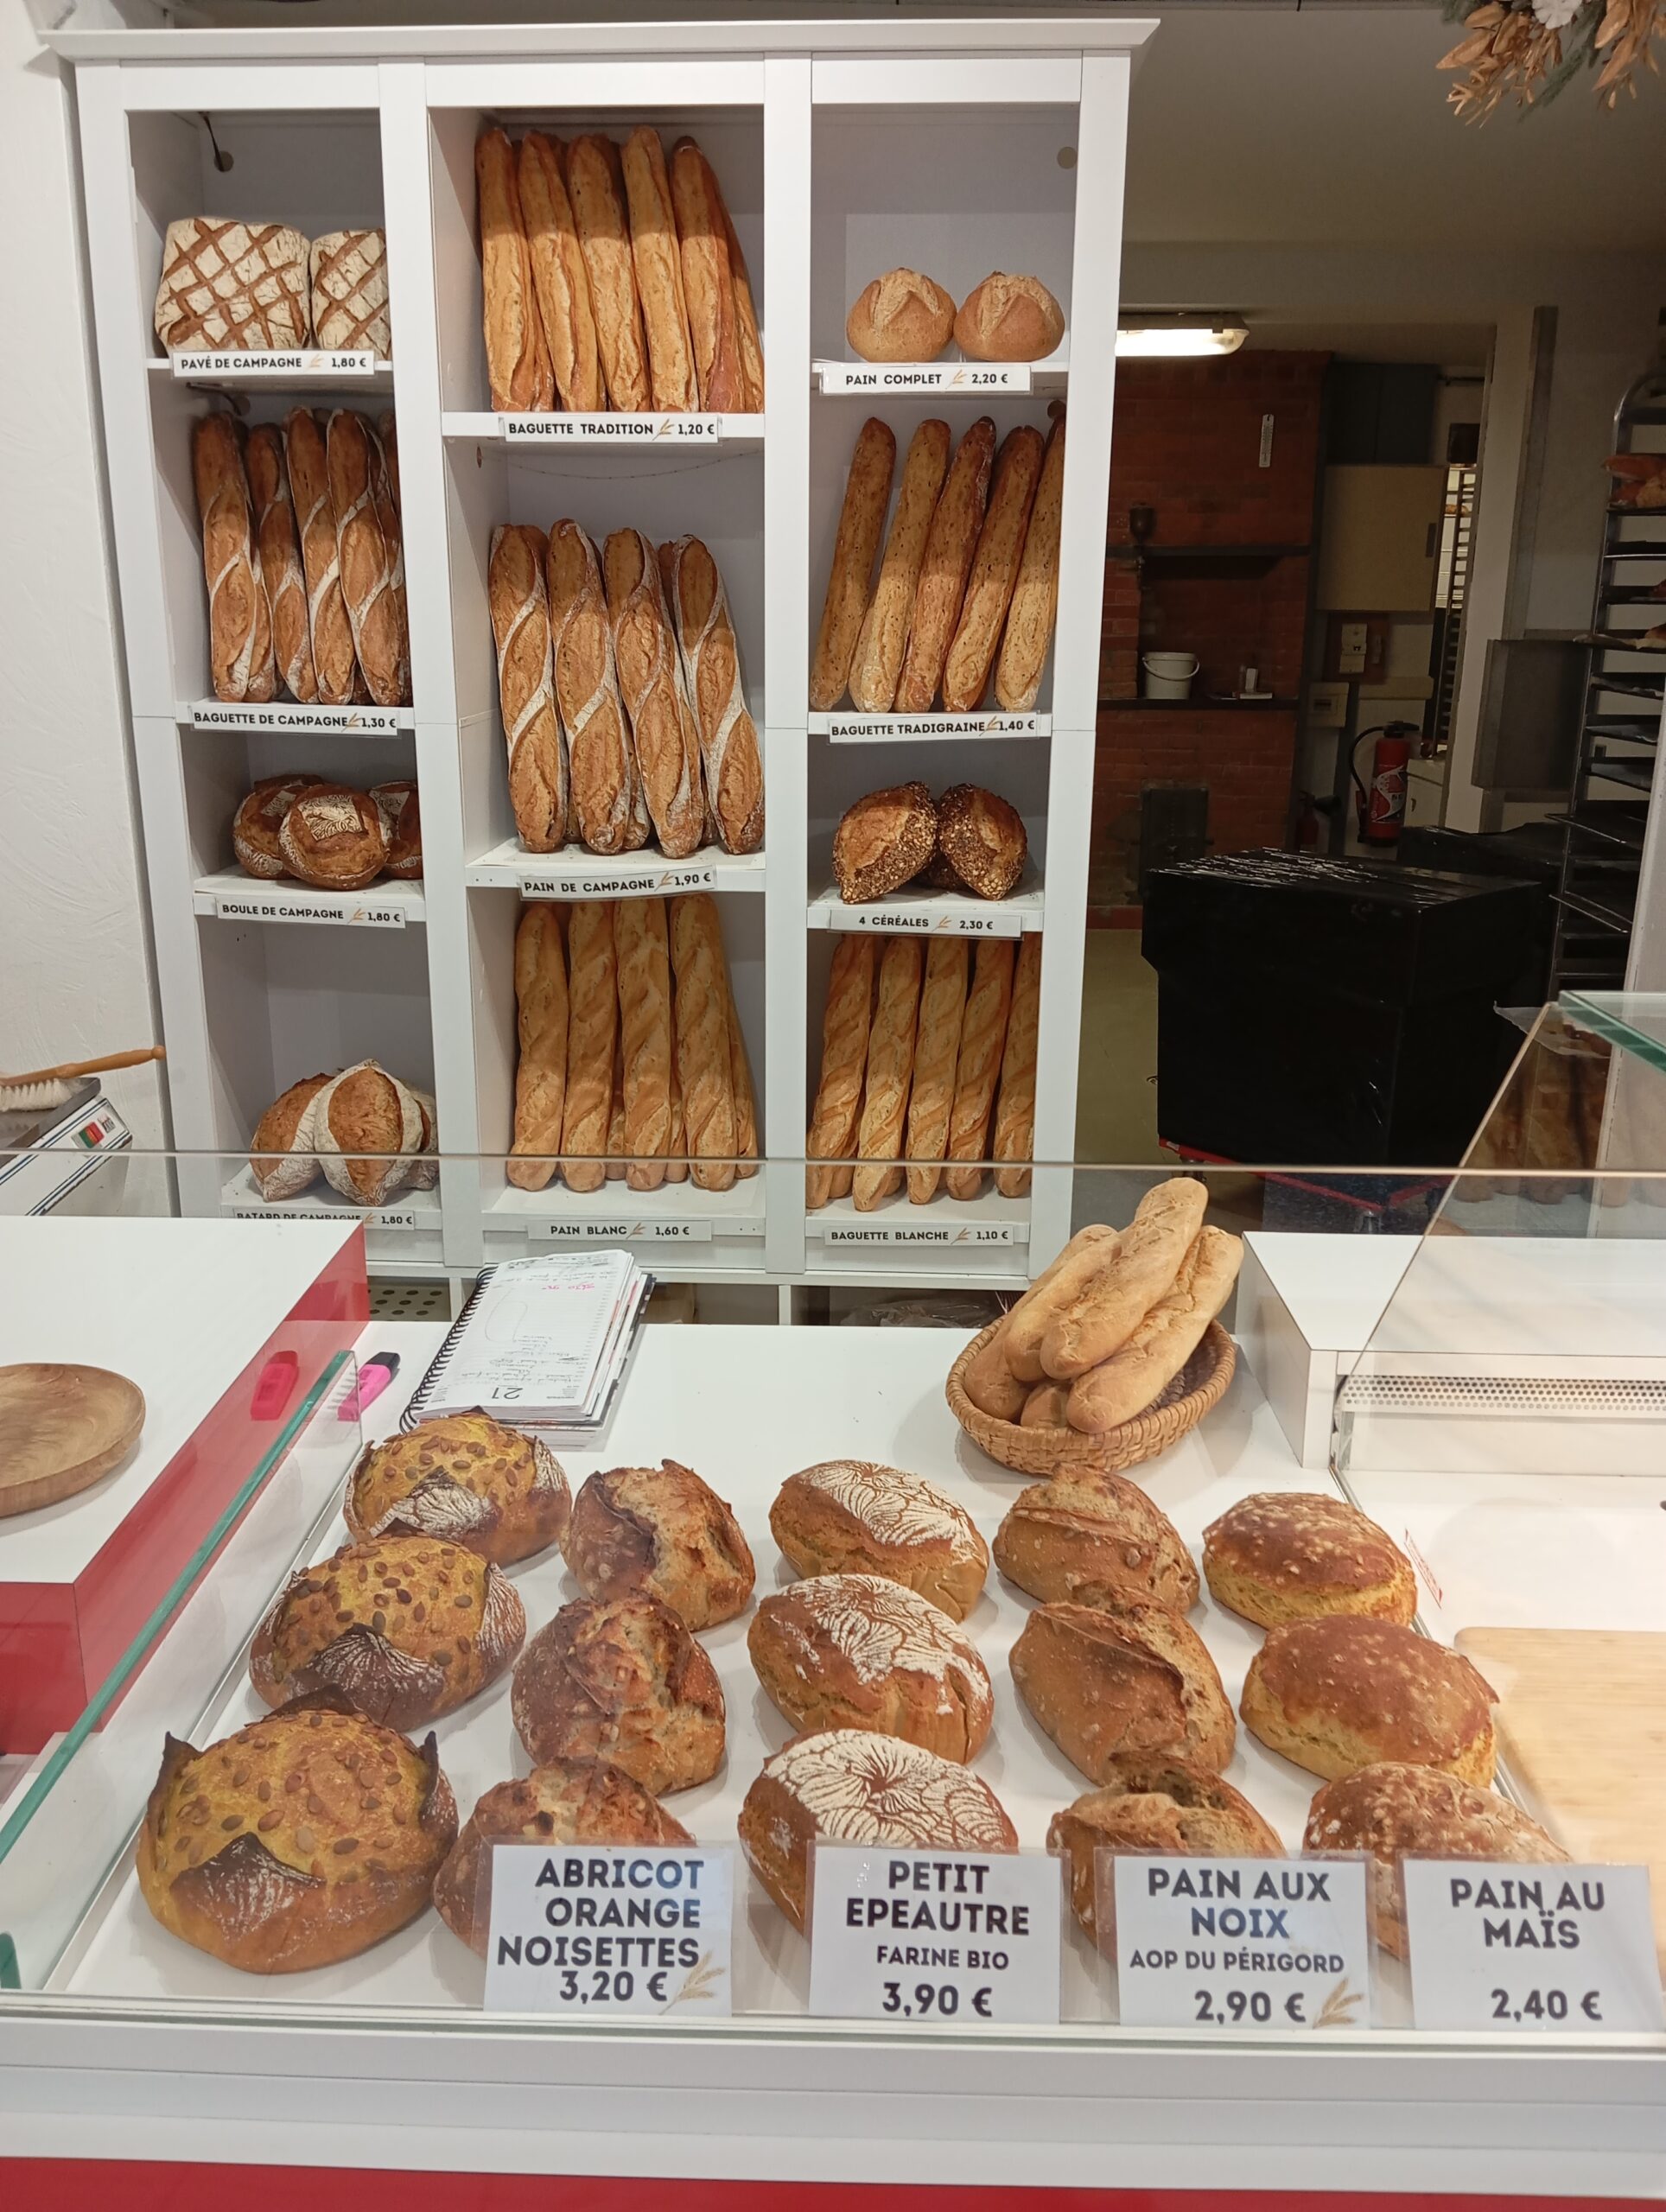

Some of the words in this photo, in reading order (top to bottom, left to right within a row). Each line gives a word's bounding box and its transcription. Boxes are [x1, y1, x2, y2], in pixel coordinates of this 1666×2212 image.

[181, 355, 212, 369] PAVÉ
[215, 359, 231, 368] DE
[233, 358, 302, 368] CAMPAGNE
[331, 358, 356, 369] 1,80
[359, 358, 366, 367] €
[845, 375, 876, 385] PAIN
[884, 373, 942, 385] COMPLET
[971, 373, 997, 385] 2,20
[1001, 373, 1008, 384] €
[508, 423, 574, 435] BAGUETTE
[580, 423, 653, 435] TRADITION
[677, 424, 703, 435] 1,20
[707, 424, 715, 435] €
[194, 713, 256, 724] BAGUETTE
[258, 715, 275, 724] DE
[277, 715, 347, 727] CAMPAGNE
[361, 718, 385, 728] 1,30
[389, 719, 397, 728] €
[831, 724, 893, 735] BAGUETTE
[897, 721, 985, 734] TRADIGRAINE
[999, 721, 1024, 733] 1,40
[1027, 720, 1035, 730] €
[524, 882, 555, 893] PAIN
[561, 882, 576, 893] DE
[582, 879, 654, 893] CAMPAGNE
[674, 874, 699, 887] 1,90
[703, 873, 711, 882] €
[222, 904, 258, 915] BOULE
[262, 906, 277, 916] DE
[279, 907, 344, 919] CAMPAGNE
[367, 912, 390, 923] 1,80
[393, 913, 401, 922] €
[859, 916, 866, 925] 4
[872, 914, 929, 927] CÉRÉALES
[959, 920, 983, 931] 2,30
[986, 920, 993, 930] €
[381, 1216, 403, 1225] 1,80
[405, 1216, 412, 1224] €
[550, 1226, 580, 1235] PAIN
[587, 1226, 627, 1235] BLANC
[655, 1226, 679, 1236] 1,60
[682, 1226, 690, 1236] €
[831, 1231, 889, 1240] BAGUETTE
[895, 1231, 949, 1240] BLANCHE
[976, 1231, 998, 1241] 1,10
[1002, 1230, 1008, 1240] €
[492, 1387, 523, 1400] 21
[535, 1859, 704, 1890] ABRICOT
[888, 1860, 989, 1894] PETIT
[1148, 1868, 1241, 1899] PAIN
[1253, 1871, 1331, 1902] AUX
[1450, 1878, 1543, 1910] PAIN
[1556, 1881, 1605, 1911] AU
[545, 1897, 700, 1929] ORANGE
[846, 1897, 1029, 1936] EPEAUTRE
[1191, 1907, 1289, 1939] NOIX
[1484, 1910, 1580, 1948] MAÏS
[497, 1936, 699, 1967] NOISETTES
[876, 1945, 959, 1967] FARINE
[967, 1950, 1009, 1970] BIO
[1129, 1949, 1178, 1969] AOP
[1186, 1951, 1216, 1970] DU
[1224, 1947, 1344, 1973] PÉRIGORD
[560, 1970, 634, 2005] 3,20
[646, 1971, 668, 2002] €
[882, 1982, 959, 2016] 3,90
[971, 1987, 993, 2018] €
[1194, 1990, 1272, 2024] 2,90
[1284, 1993, 1306, 2023] €
[1491, 1988, 1568, 2022] 2,40
[1580, 1990, 1602, 2021] €
